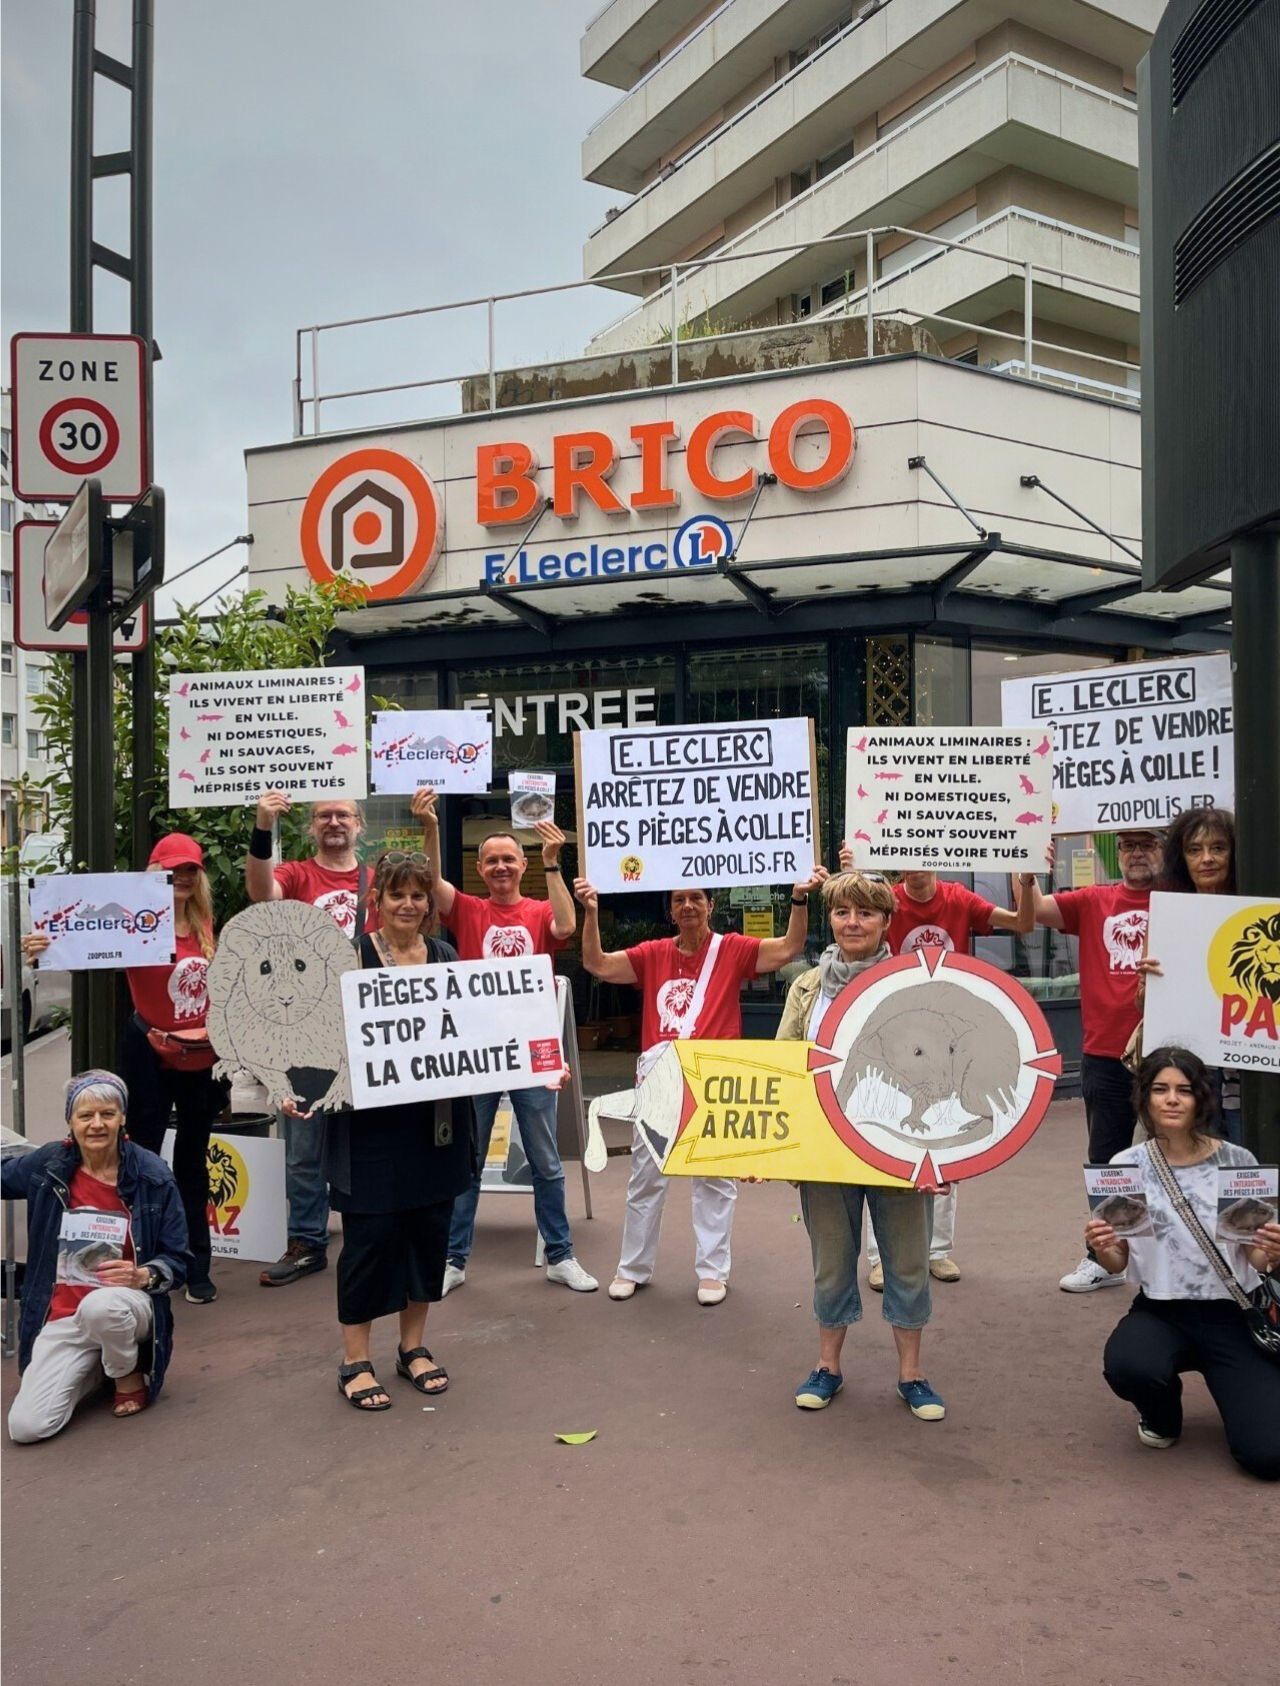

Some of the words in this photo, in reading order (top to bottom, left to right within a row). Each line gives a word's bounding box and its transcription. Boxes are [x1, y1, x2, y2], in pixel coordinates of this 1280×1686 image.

[38, 359, 119, 383] ZONE
[58, 420, 101, 452] 30
[477, 399, 855, 527] BRICO
[484, 543, 668, 584] E.Leclerc
[189, 679, 254, 692] ANIMAUX
[258, 676, 335, 689] LIMINAIRES
[1037, 687, 1064, 715] E.
[1073, 672, 1191, 712] LECLERC
[189, 699, 210, 709] ILS
[213, 697, 262, 708] VIVENT
[267, 695, 285, 705] EN
[289, 690, 344, 704] LIBERTÉ
[235, 713, 253, 723] EN
[257, 711, 298, 722] VILLE.
[1115, 716, 1143, 746] DE
[1152, 706, 1234, 741] VENDRE
[207, 731, 221, 741] NI
[225, 726, 327, 740] DOMESTIQUES,
[868, 736, 935, 747] ANIMAUX
[939, 736, 1022, 747] LIMINAIRES
[220, 748, 234, 758] NI
[238, 745, 315, 757] SAUVAGES,
[620, 741, 642, 768] E.
[650, 733, 765, 767] LECLERC
[867, 755, 888, 765] ILS
[892, 755, 942, 765] VIVENT
[948, 755, 967, 765] EN
[972, 750, 1031, 766] LIBERTÉ
[205, 766, 225, 776] ILS
[229, 764, 266, 775] SONT
[270, 760, 334, 773] SOUVENT
[1119, 750, 1136, 785] À
[1139, 750, 1206, 783] COLLE
[193, 780, 261, 795] MÉPRISÉS
[265, 779, 307, 791] VOIRE
[311, 777, 346, 788] TUÉS
[914, 773, 933, 783] EN
[937, 773, 982, 784] VILLE.
[586, 776, 686, 809] ARRÊTEZ
[694, 776, 721, 804] DE
[727, 770, 811, 802] VENDRE
[885, 791, 900, 802] NI
[904, 791, 1011, 805] DOMESTIQUES,
[897, 810, 912, 820] NI
[916, 810, 998, 823] SAUVAGES,
[588, 820, 631, 848] DES
[716, 807, 733, 843] À
[881, 828, 902, 838] ILS
[906, 828, 946, 839] SONT
[949, 829, 1017, 840] SOUVENT
[869, 844, 940, 858] MÉPRISÉS
[943, 847, 988, 858] VOIRE
[992, 845, 1029, 859] TUÉS
[921, 860, 972, 868] ZOOPOLIS.FR
[622, 872, 641, 882] PAZ
[1109, 951, 1138, 971] PA
[446, 967, 463, 1000] À
[1220, 993, 1279, 1042] PA
[360, 1016, 427, 1048] STOP
[440, 1007, 459, 1040] À
[365, 1059, 401, 1088] LA
[410, 1038, 522, 1083] CRUAUTÉ
[1223, 1052, 1280, 1068] ZOOPOLI
[704, 1075, 782, 1106] COLLE
[701, 1109, 717, 1139] À
[723, 1109, 791, 1141] RATS
[207, 1201, 241, 1236] AZ
[211, 1245, 239, 1255] OLIS.FR
